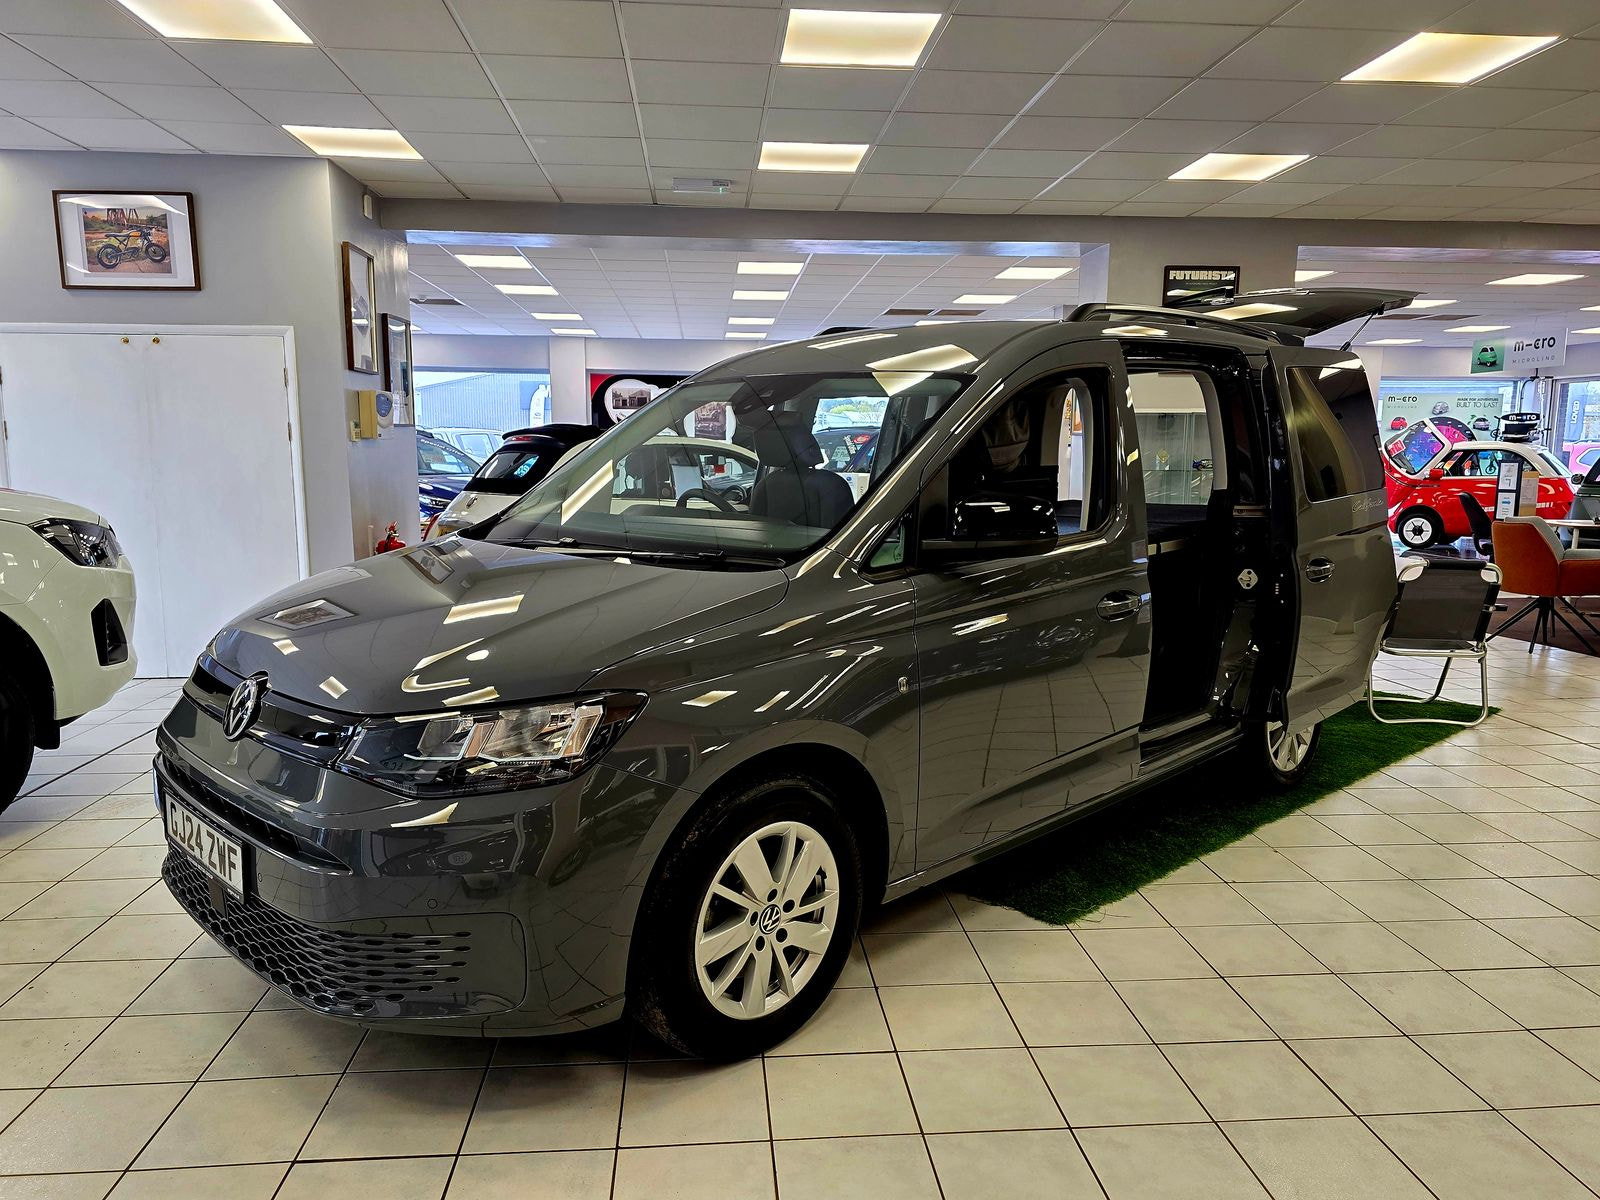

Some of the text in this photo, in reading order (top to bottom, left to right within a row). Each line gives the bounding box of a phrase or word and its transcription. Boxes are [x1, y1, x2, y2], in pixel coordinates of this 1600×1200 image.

[1169, 270, 1235, 281] FUTURISTA
[1512, 354, 1556, 364] MICROLINO
[1571, 400, 1580, 424] LOVED
[170, 802, 204, 859] GJ24
[206, 829, 238, 882] ZWF
